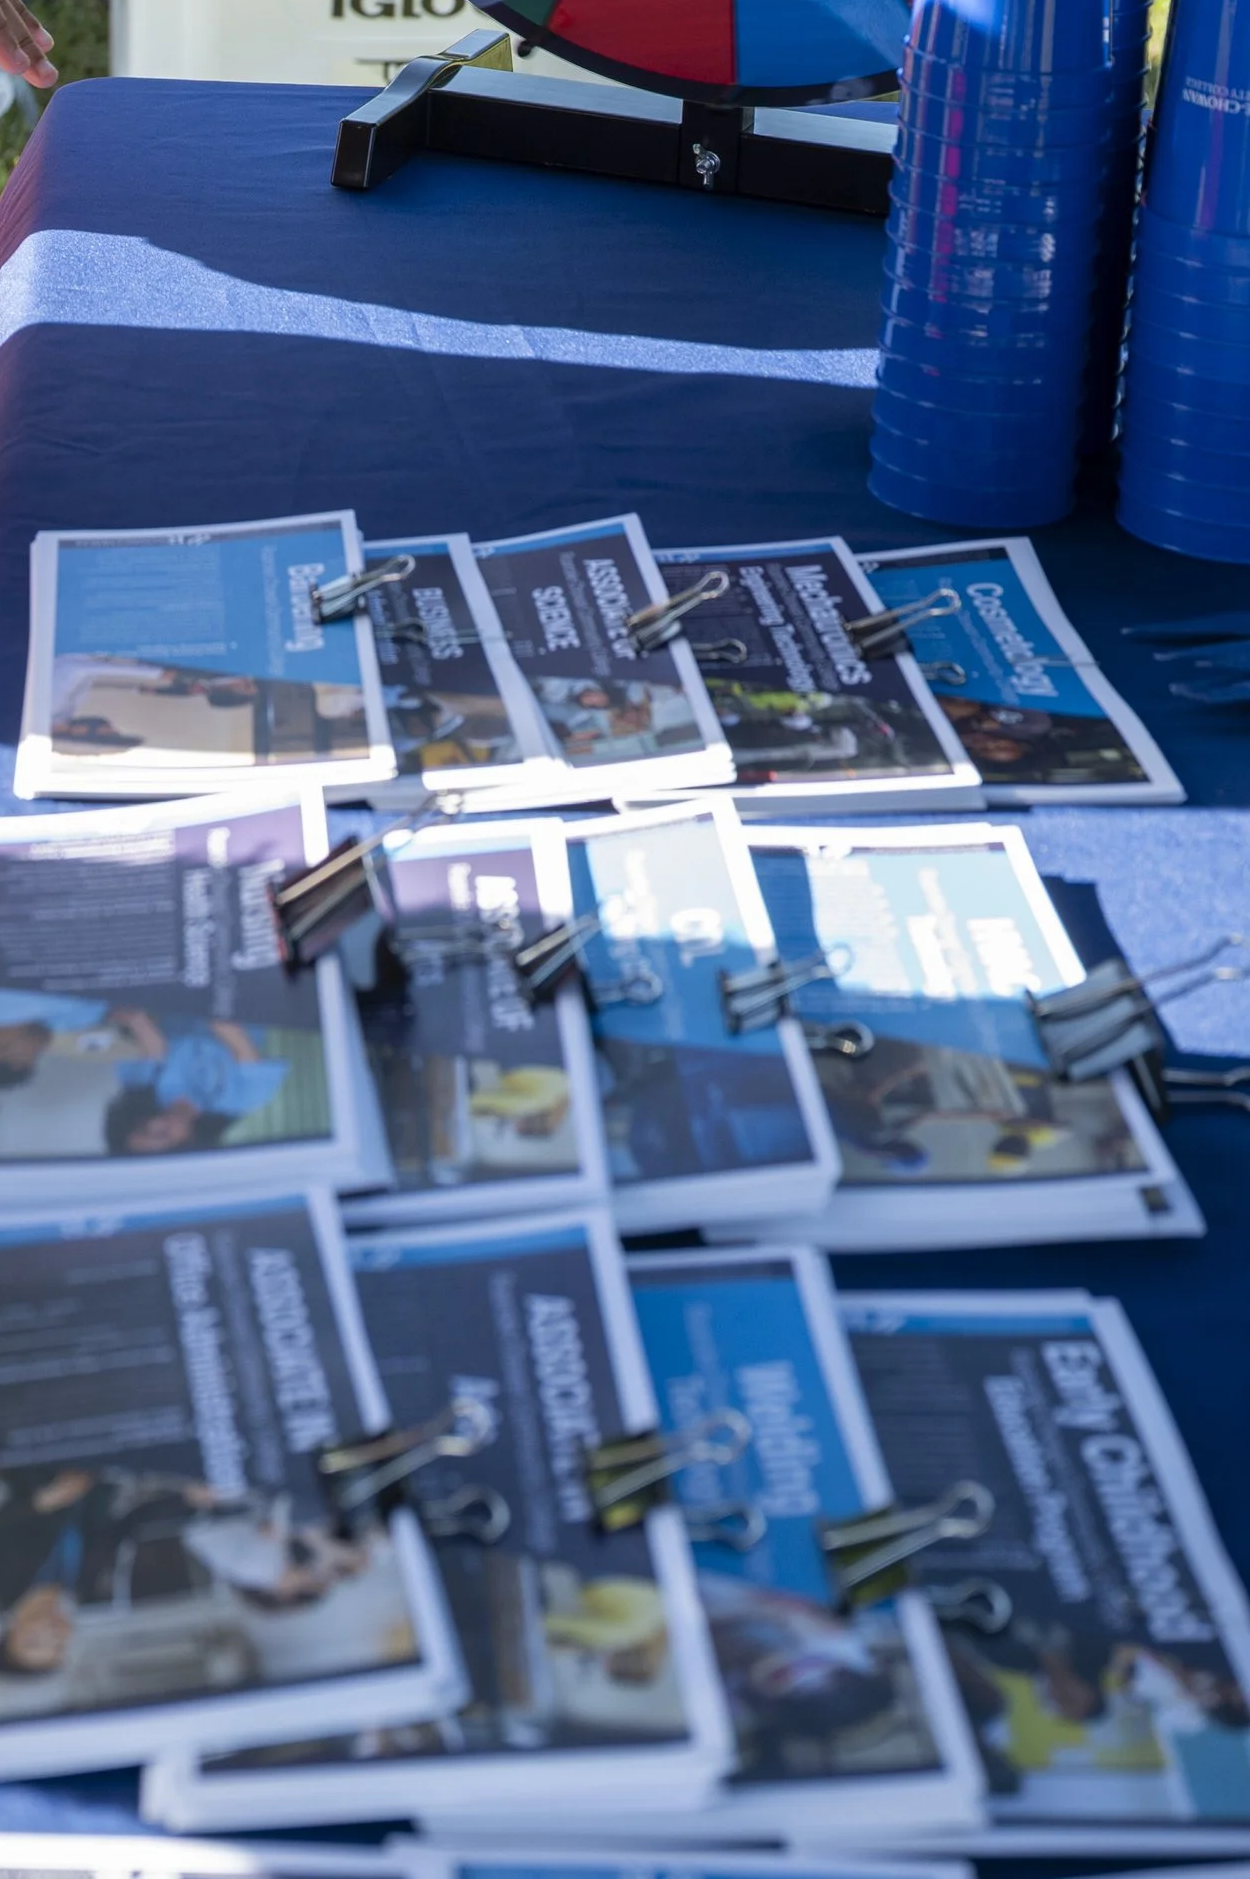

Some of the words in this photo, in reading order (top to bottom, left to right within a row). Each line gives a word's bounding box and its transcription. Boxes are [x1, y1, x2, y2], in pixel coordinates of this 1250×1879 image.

[412, 587, 464, 659] BUSINESS
[532, 585, 581, 652] SCIENCE
[740, 566, 784, 628] Engineering
[770, 622, 817, 694] Technology
[784, 565, 872, 685] Mechatronics
[967, 582, 1059, 697] Cosmetology
[163, 1232, 212, 1310] Office
[251, 1247, 332, 1413] ASSOCIATE
[1042, 1340, 1121, 1431] Early
[735, 1360, 822, 1519] Welding
[1080, 1433, 1216, 1642] Childhood
